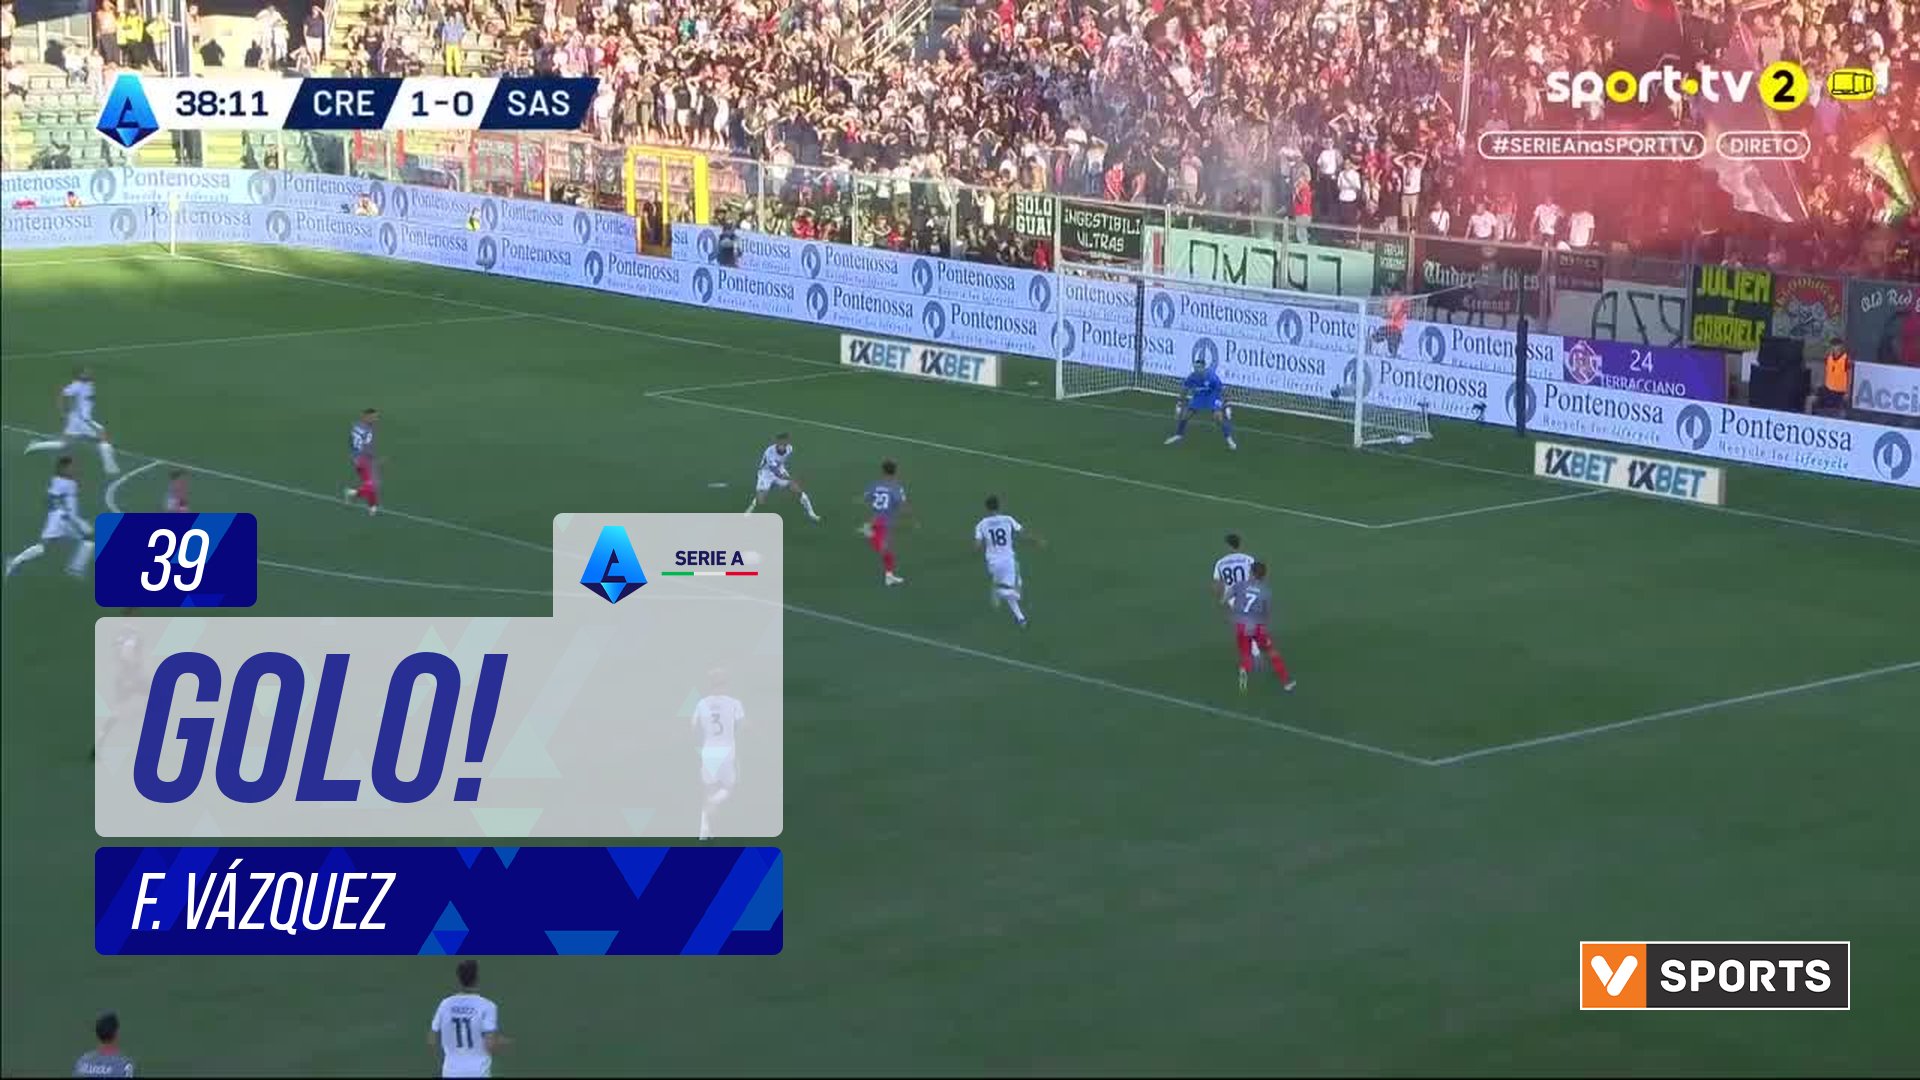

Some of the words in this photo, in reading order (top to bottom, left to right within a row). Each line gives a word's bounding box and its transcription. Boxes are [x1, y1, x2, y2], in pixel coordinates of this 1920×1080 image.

[123, 166, 230, 189] Pontenossa
[1016, 194, 1052, 216] SOLO
[401, 225, 468, 252] Pontenossa
[1016, 214, 1052, 236] GUAI
[1077, 229, 1125, 252] ULTRAS
[501, 238, 572, 266] Pontenossa
[608, 251, 680, 284] Pontenossa
[825, 245, 899, 275] Pontenossa
[718, 269, 795, 301] Pontenossa
[937, 262, 1016, 292] Pontenossa
[833, 286, 914, 319] Pontenossa
[1180, 294, 1268, 327] Pontenossa
[950, 303, 1038, 336] Pontenossa
[849, 339, 912, 370] 1XBET
[919, 349, 986, 383] 1XBET
[1225, 339, 1326, 376] Pontenossa
[1629, 350, 1654, 372] 24
[1380, 360, 1489, 398] Pontenossa
[1599, 373, 1687, 397] TERRACCIANO
[1544, 383, 1664, 424] Pontenossa
[1719, 408, 1852, 451] Pontenossa
[1545, 446, 1618, 484] 1XBET
[1628, 459, 1707, 499] 1XBET
[988, 528, 1008, 547] 18
[1222, 565, 1245, 586] 80
[1243, 593, 1258, 613] 7
[451, 1017, 474, 1049] 11
